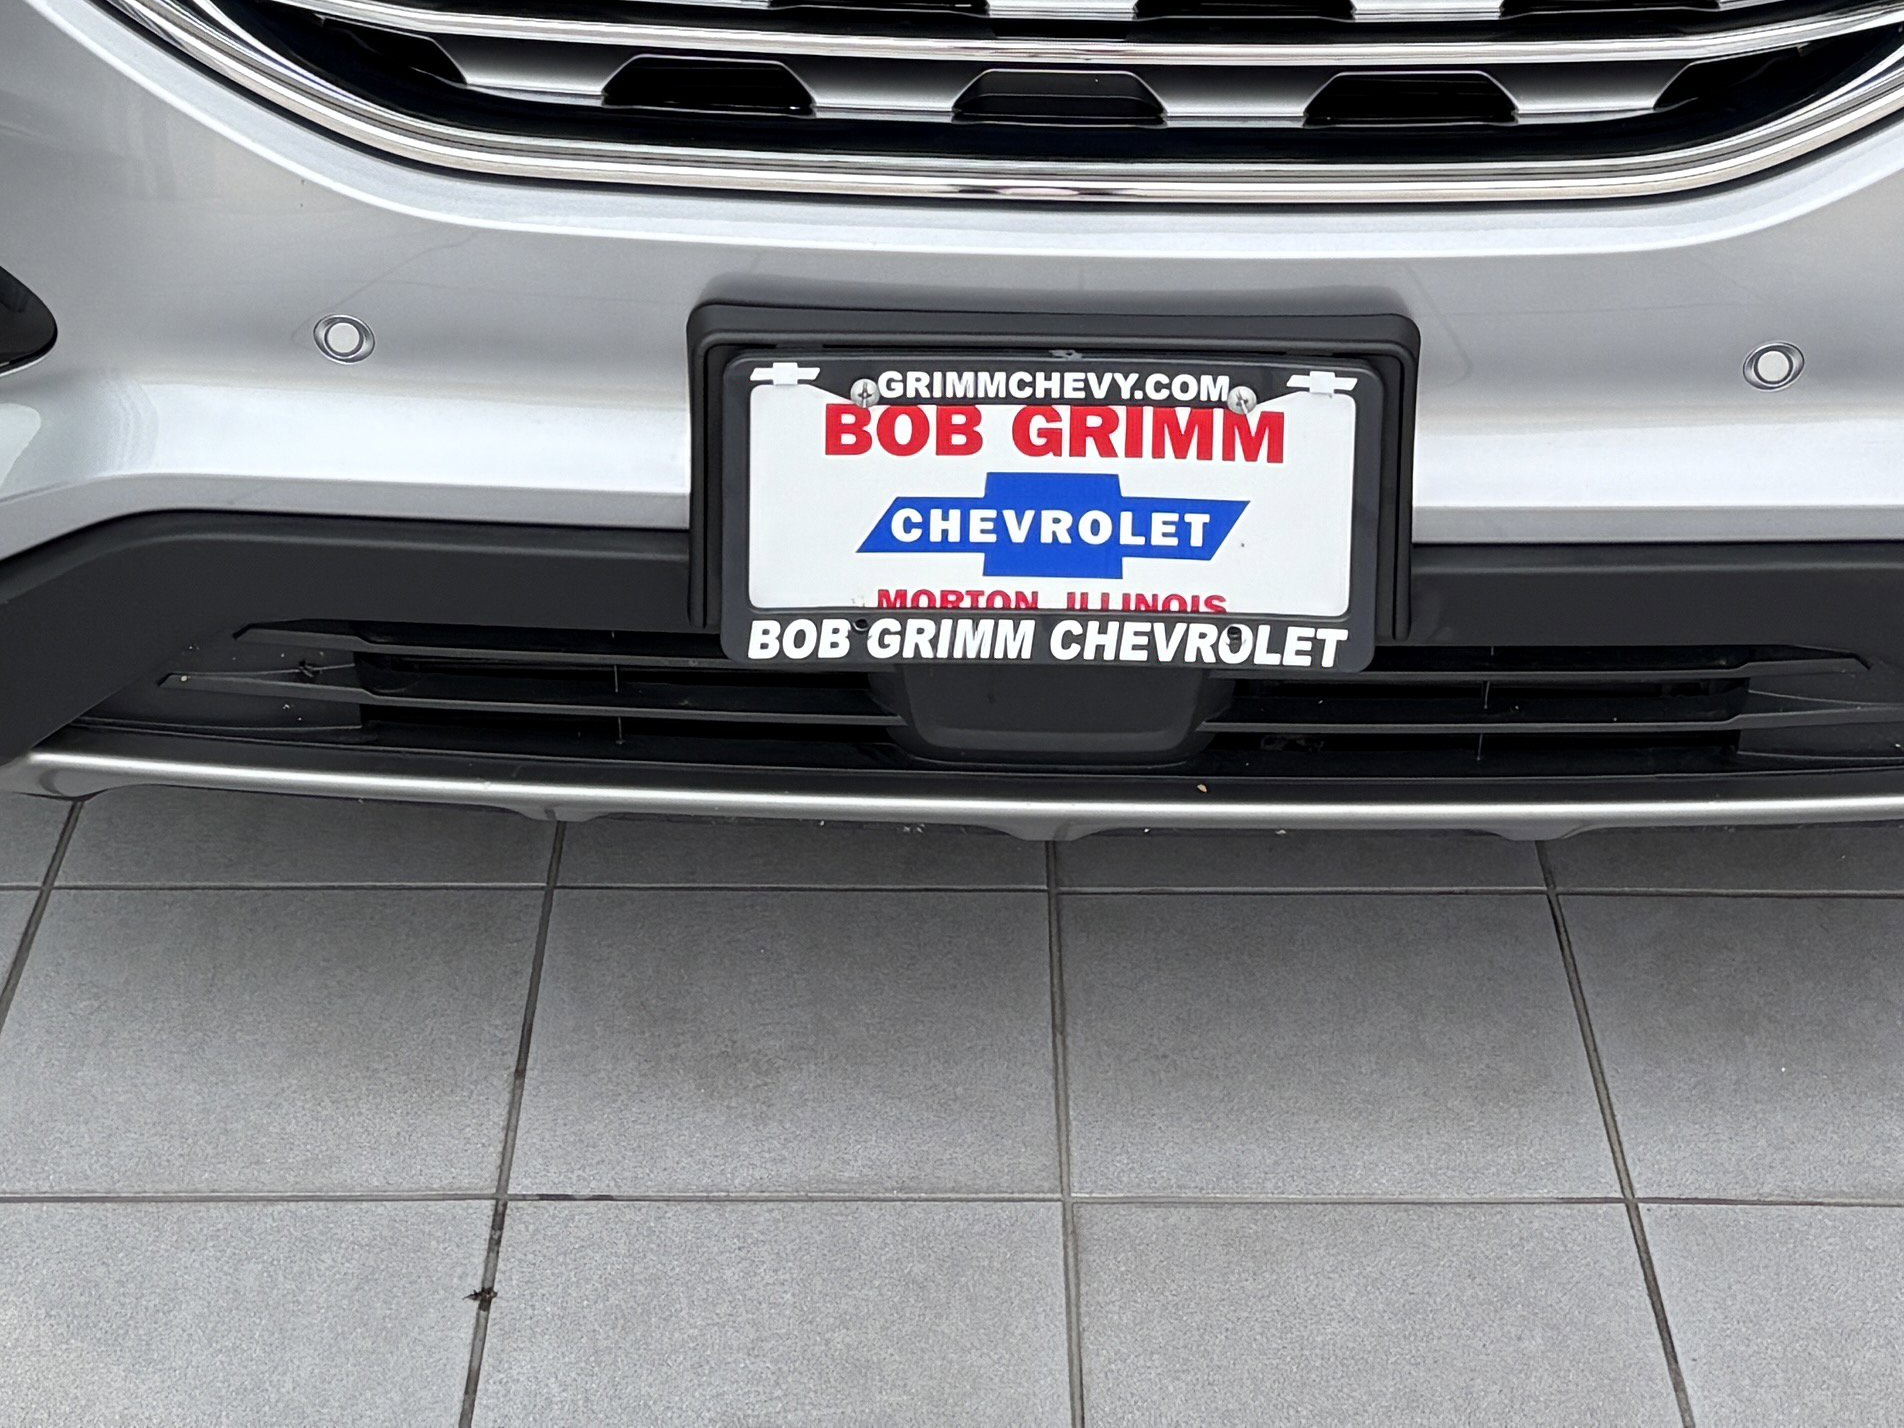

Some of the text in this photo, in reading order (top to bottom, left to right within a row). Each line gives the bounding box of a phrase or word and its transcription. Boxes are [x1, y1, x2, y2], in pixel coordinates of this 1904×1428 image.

[876, 370, 1231, 403] GRIMMCHEVY.COM
[825, 403, 1285, 464] BOB GRIMM
[891, 507, 1211, 548] CHEVROLET
[747, 618, 1348, 668] BOB GRIMM CHEVROLET
